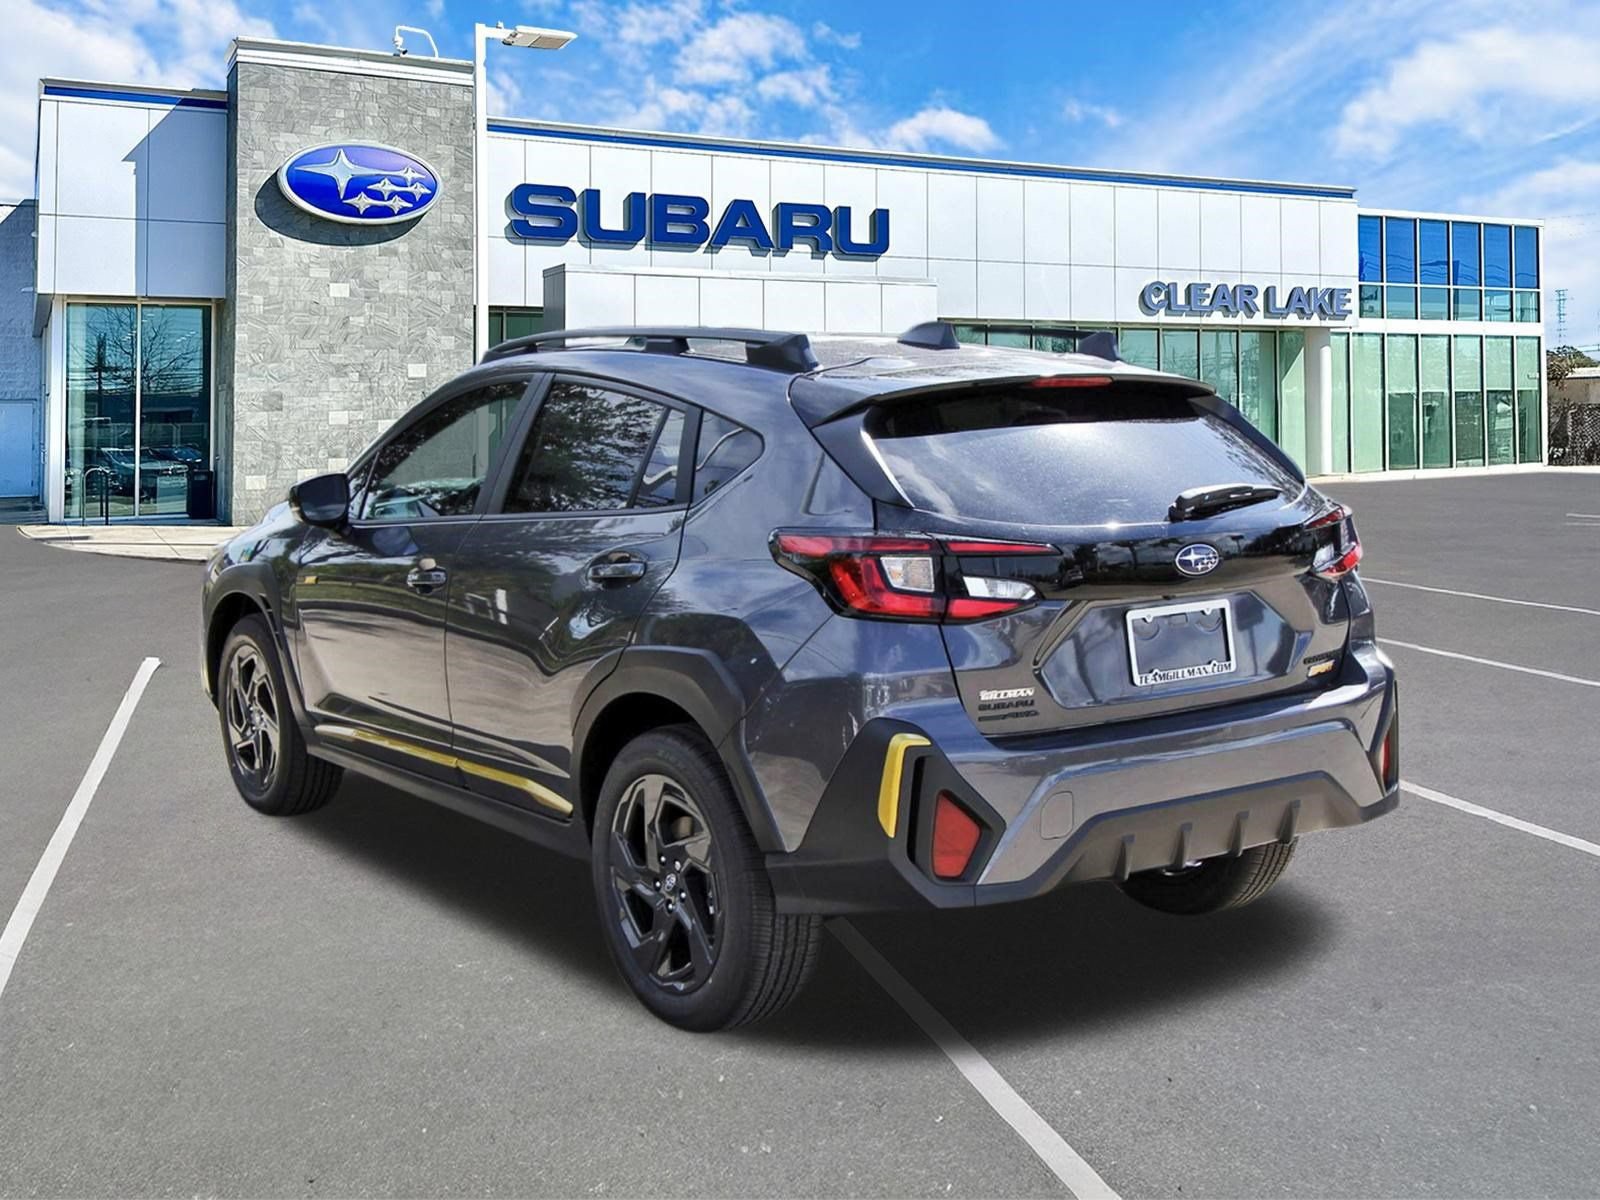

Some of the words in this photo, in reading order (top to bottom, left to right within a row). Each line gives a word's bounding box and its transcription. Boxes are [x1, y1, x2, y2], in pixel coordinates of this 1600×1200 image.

[506, 183, 890, 259] SUBARU
[1139, 281, 1260, 317] CLEAR
[1264, 285, 1353, 320] LAKE
